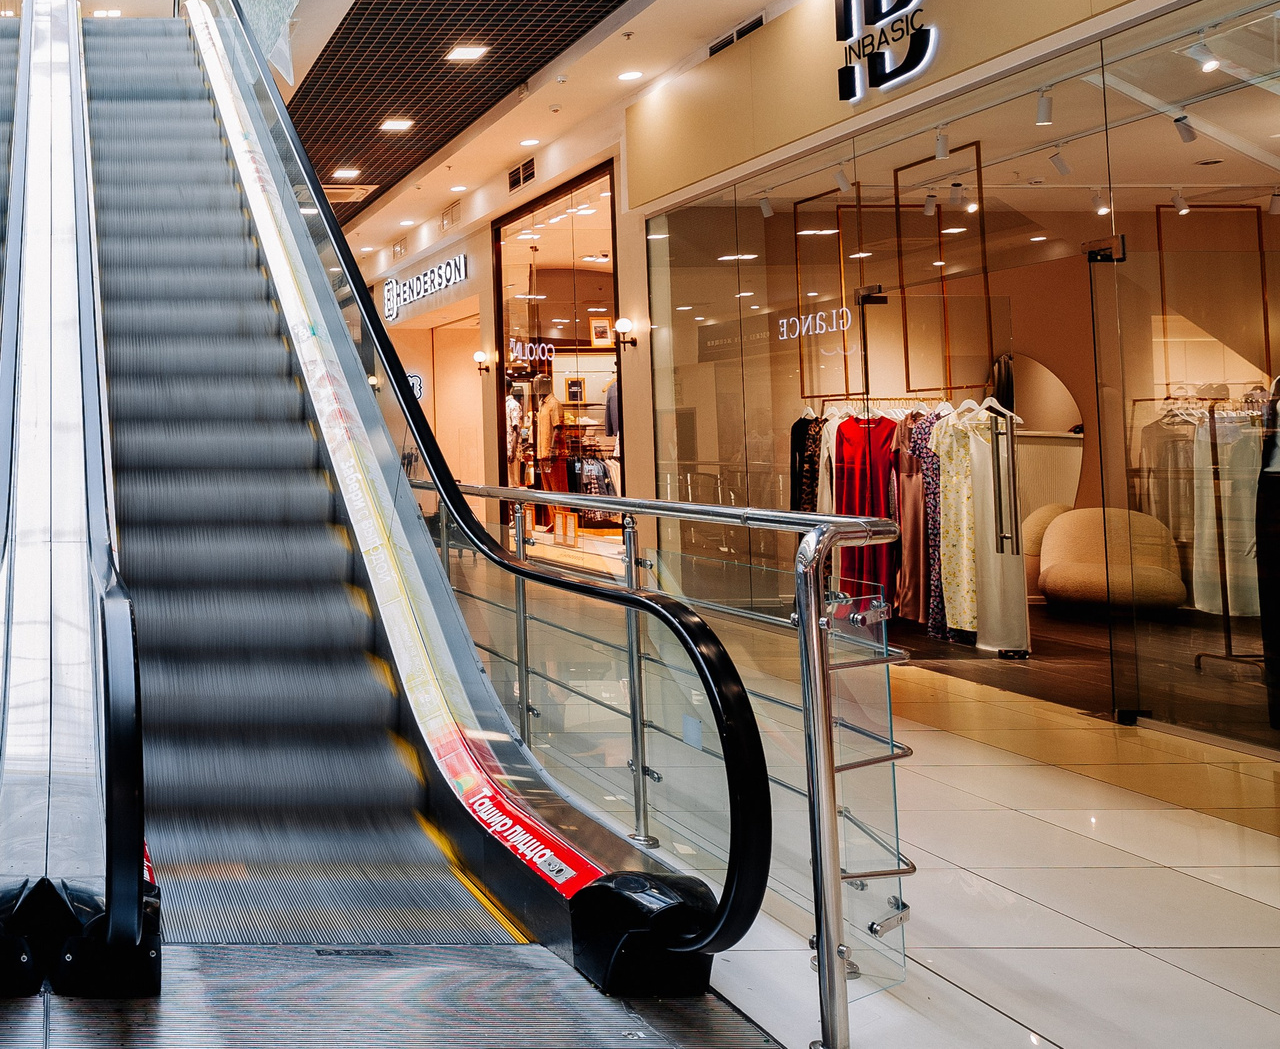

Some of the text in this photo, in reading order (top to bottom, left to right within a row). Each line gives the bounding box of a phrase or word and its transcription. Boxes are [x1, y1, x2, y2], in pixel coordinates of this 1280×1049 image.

[844, 8, 925, 67] INBASIC
[395, 253, 468, 308] HENDERSON
[341, 458, 366, 510] Забери
[469, 787, 554, 866] Ташир пицца
